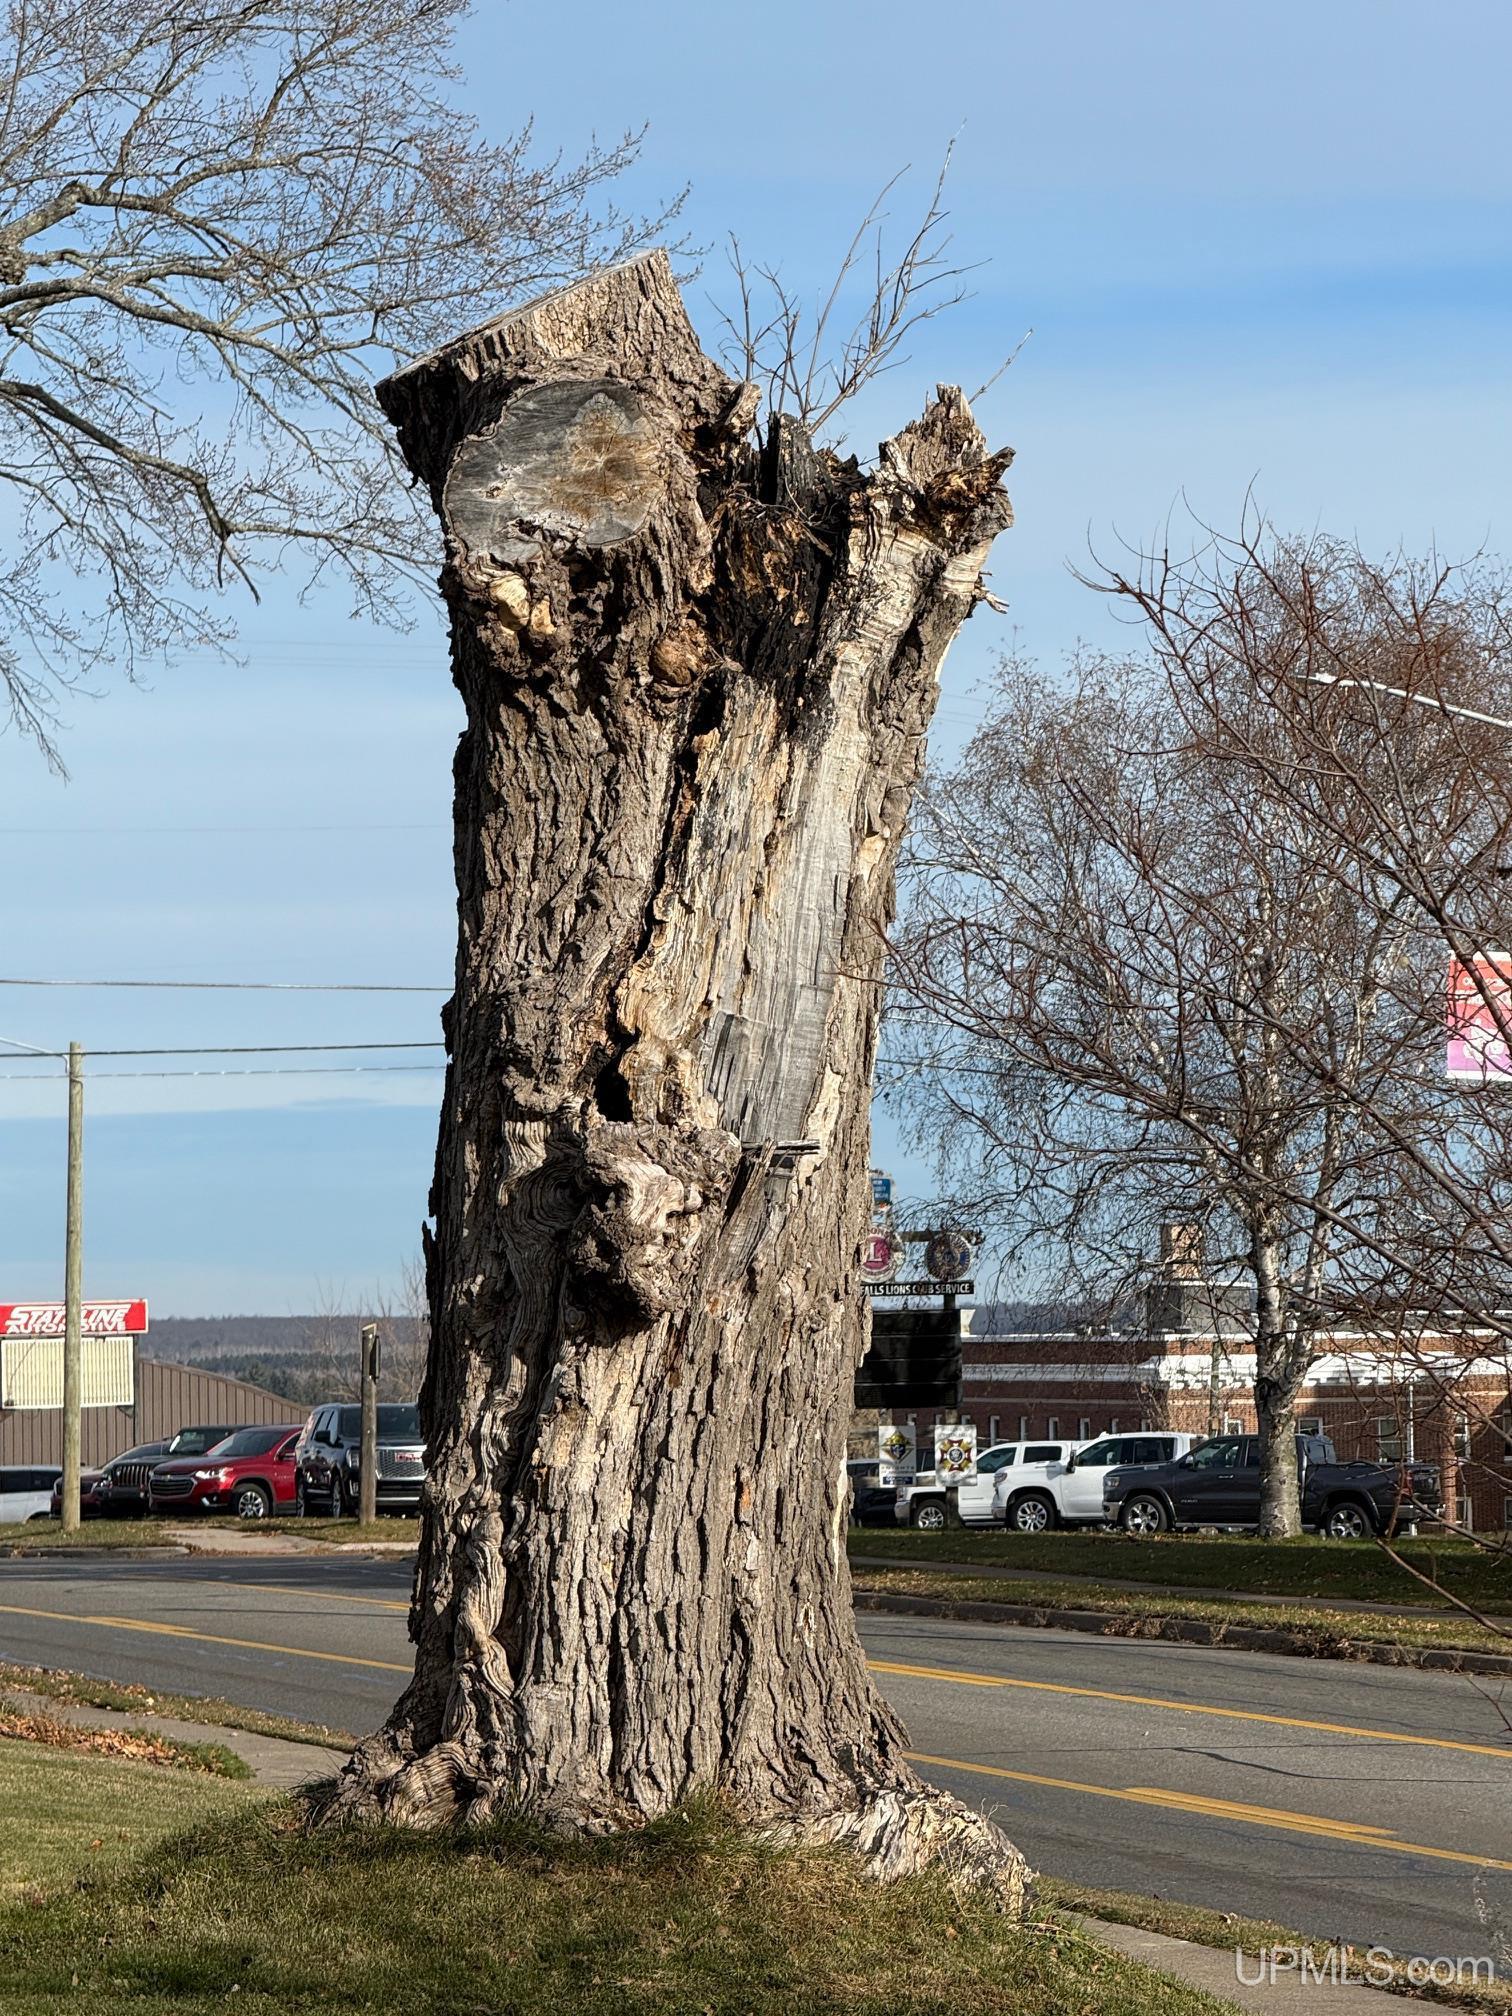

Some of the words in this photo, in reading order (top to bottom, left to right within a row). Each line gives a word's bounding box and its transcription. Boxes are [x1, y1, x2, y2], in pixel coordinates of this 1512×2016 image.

[885, 1284, 911, 1294] LIONS
[935, 1283, 970, 1294] SERVICE
[5, 1304, 132, 1325] STATLINE
